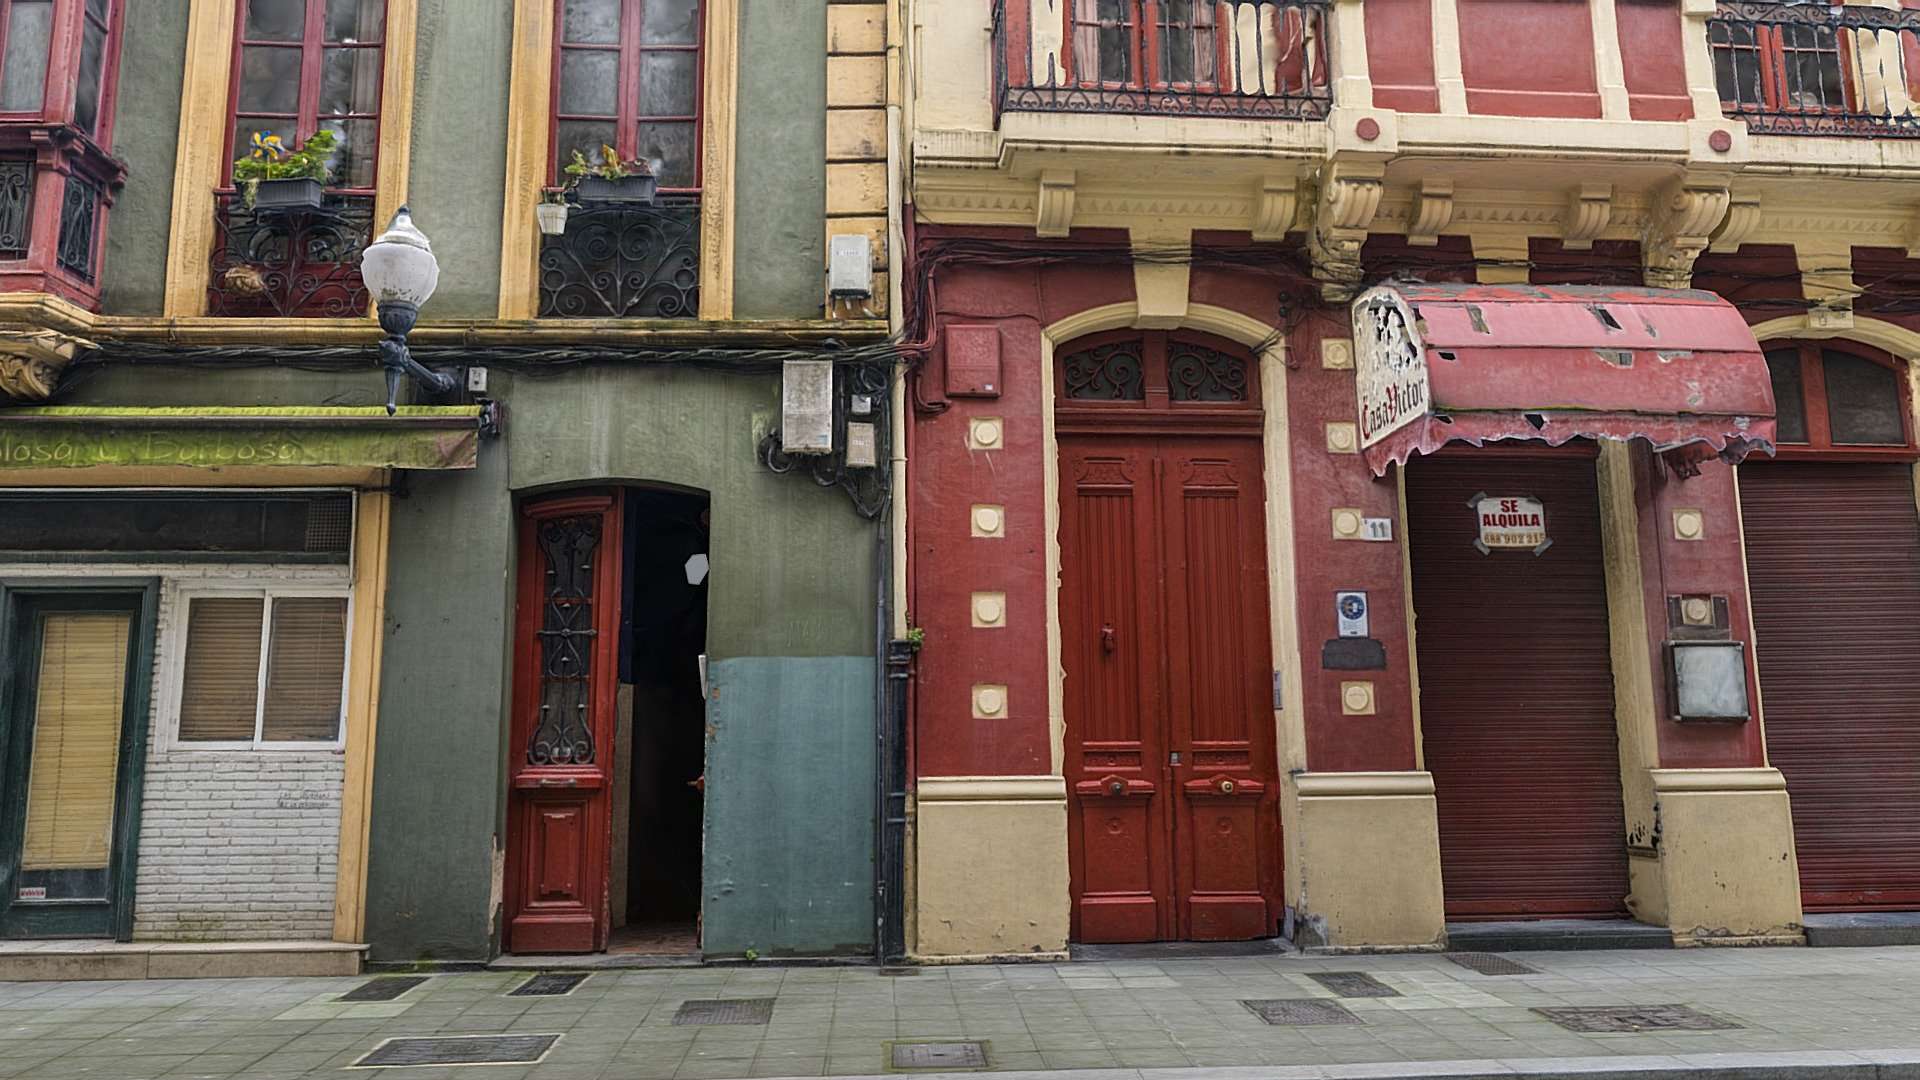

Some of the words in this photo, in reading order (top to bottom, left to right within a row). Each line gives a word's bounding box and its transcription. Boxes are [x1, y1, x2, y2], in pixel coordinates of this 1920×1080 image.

[1500, 500, 1519, 513] SE
[1483, 514, 1540, 528] ALQUILA
[1370, 521, 1386, 538] 11
